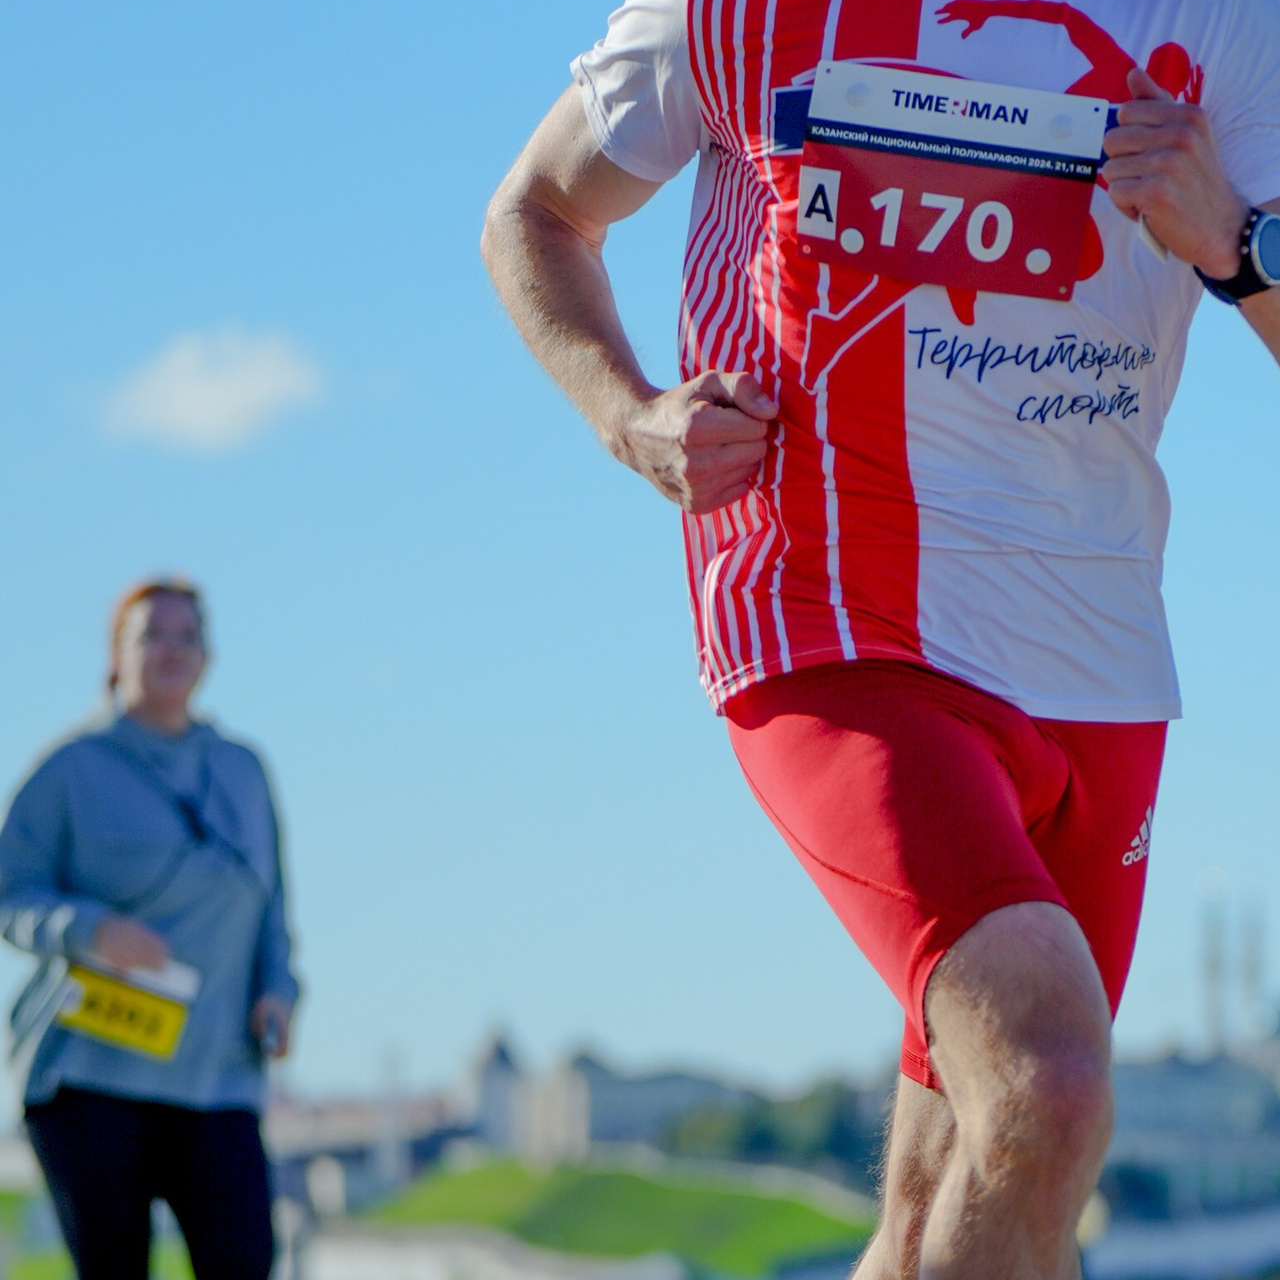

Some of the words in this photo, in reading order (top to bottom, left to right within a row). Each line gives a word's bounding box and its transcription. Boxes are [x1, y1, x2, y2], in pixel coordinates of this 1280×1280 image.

[811, 125, 869, 142] КАЗАНСКИЙ
[869, 134, 951, 155] НАЦИОНАЛЬНЫЙ
[951, 147, 1028, 166] ПОЛУМАРАФОН
[1076, 164, 1093, 176] КМ
[870, 187, 1014, 263] 170
